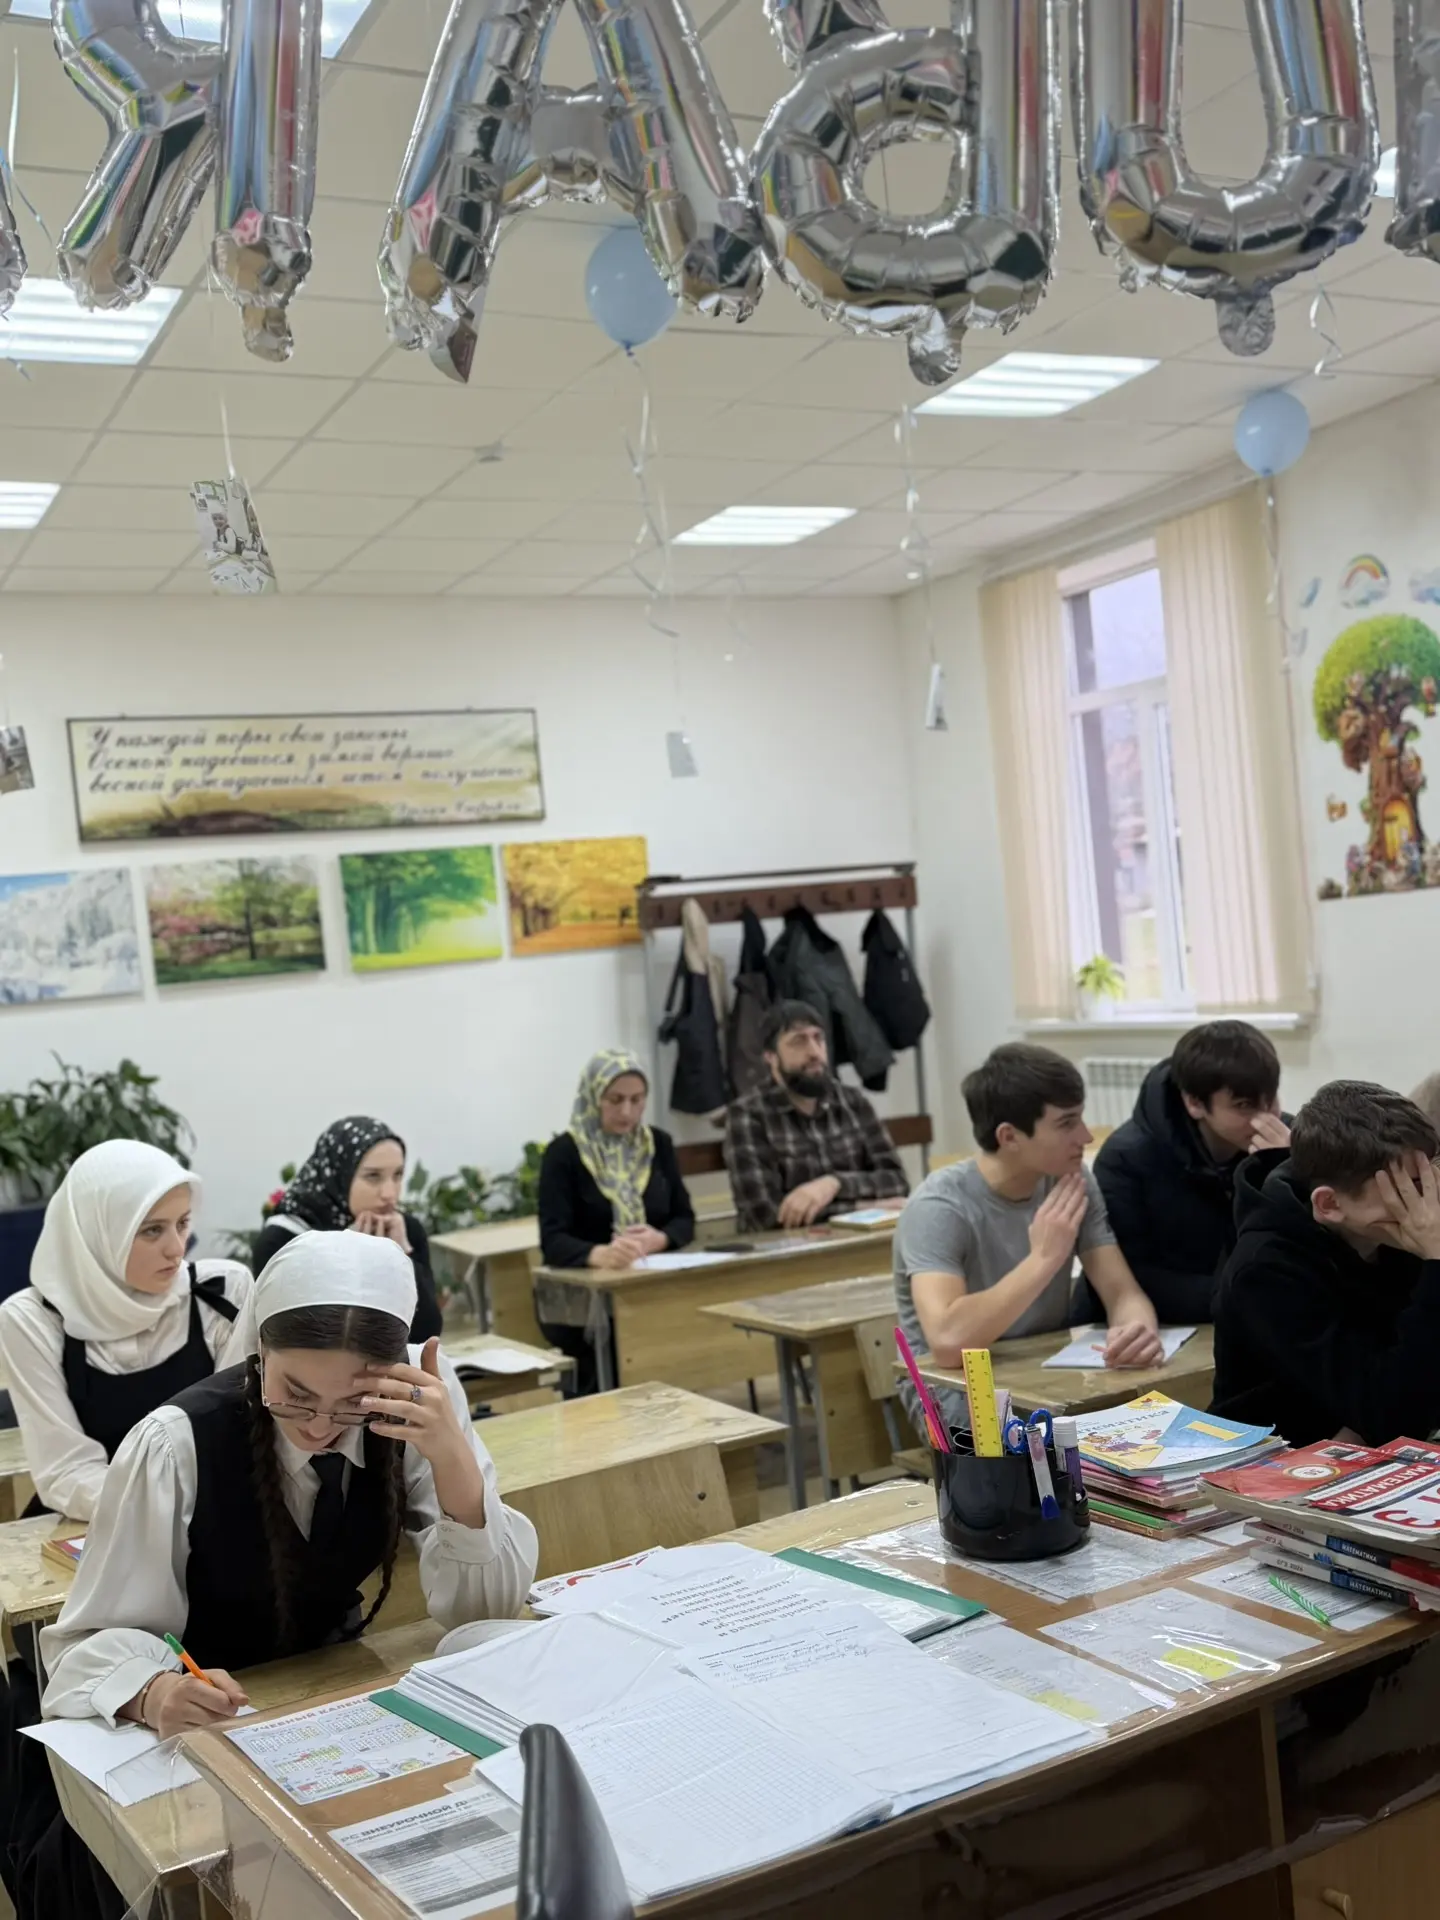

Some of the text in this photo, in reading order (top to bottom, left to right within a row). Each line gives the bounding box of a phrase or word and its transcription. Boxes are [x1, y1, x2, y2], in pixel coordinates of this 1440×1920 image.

[1077, 1411, 1169, 1435] тематика
[1318, 1465, 1435, 1507] МАТЕМАТИКА
[1341, 1544, 1378, 1563] МАТЕМАТИКА
[650, 1574, 735, 1601] Тематическое
[660, 1579, 746, 1606] планирование
[683, 1592, 732, 1608] занятий
[1350, 1581, 1393, 1600] МАТЕМАТИКА
[661, 1580, 790, 1624] математике базового
[713, 1598, 810, 1630] обучающимися
[729, 1616, 778, 1635] рамках
[251, 1711, 317, 1733] УЧЕБНЫЙ
[363, 1802, 451, 1841] ВНЕУРОЧНОЙ
